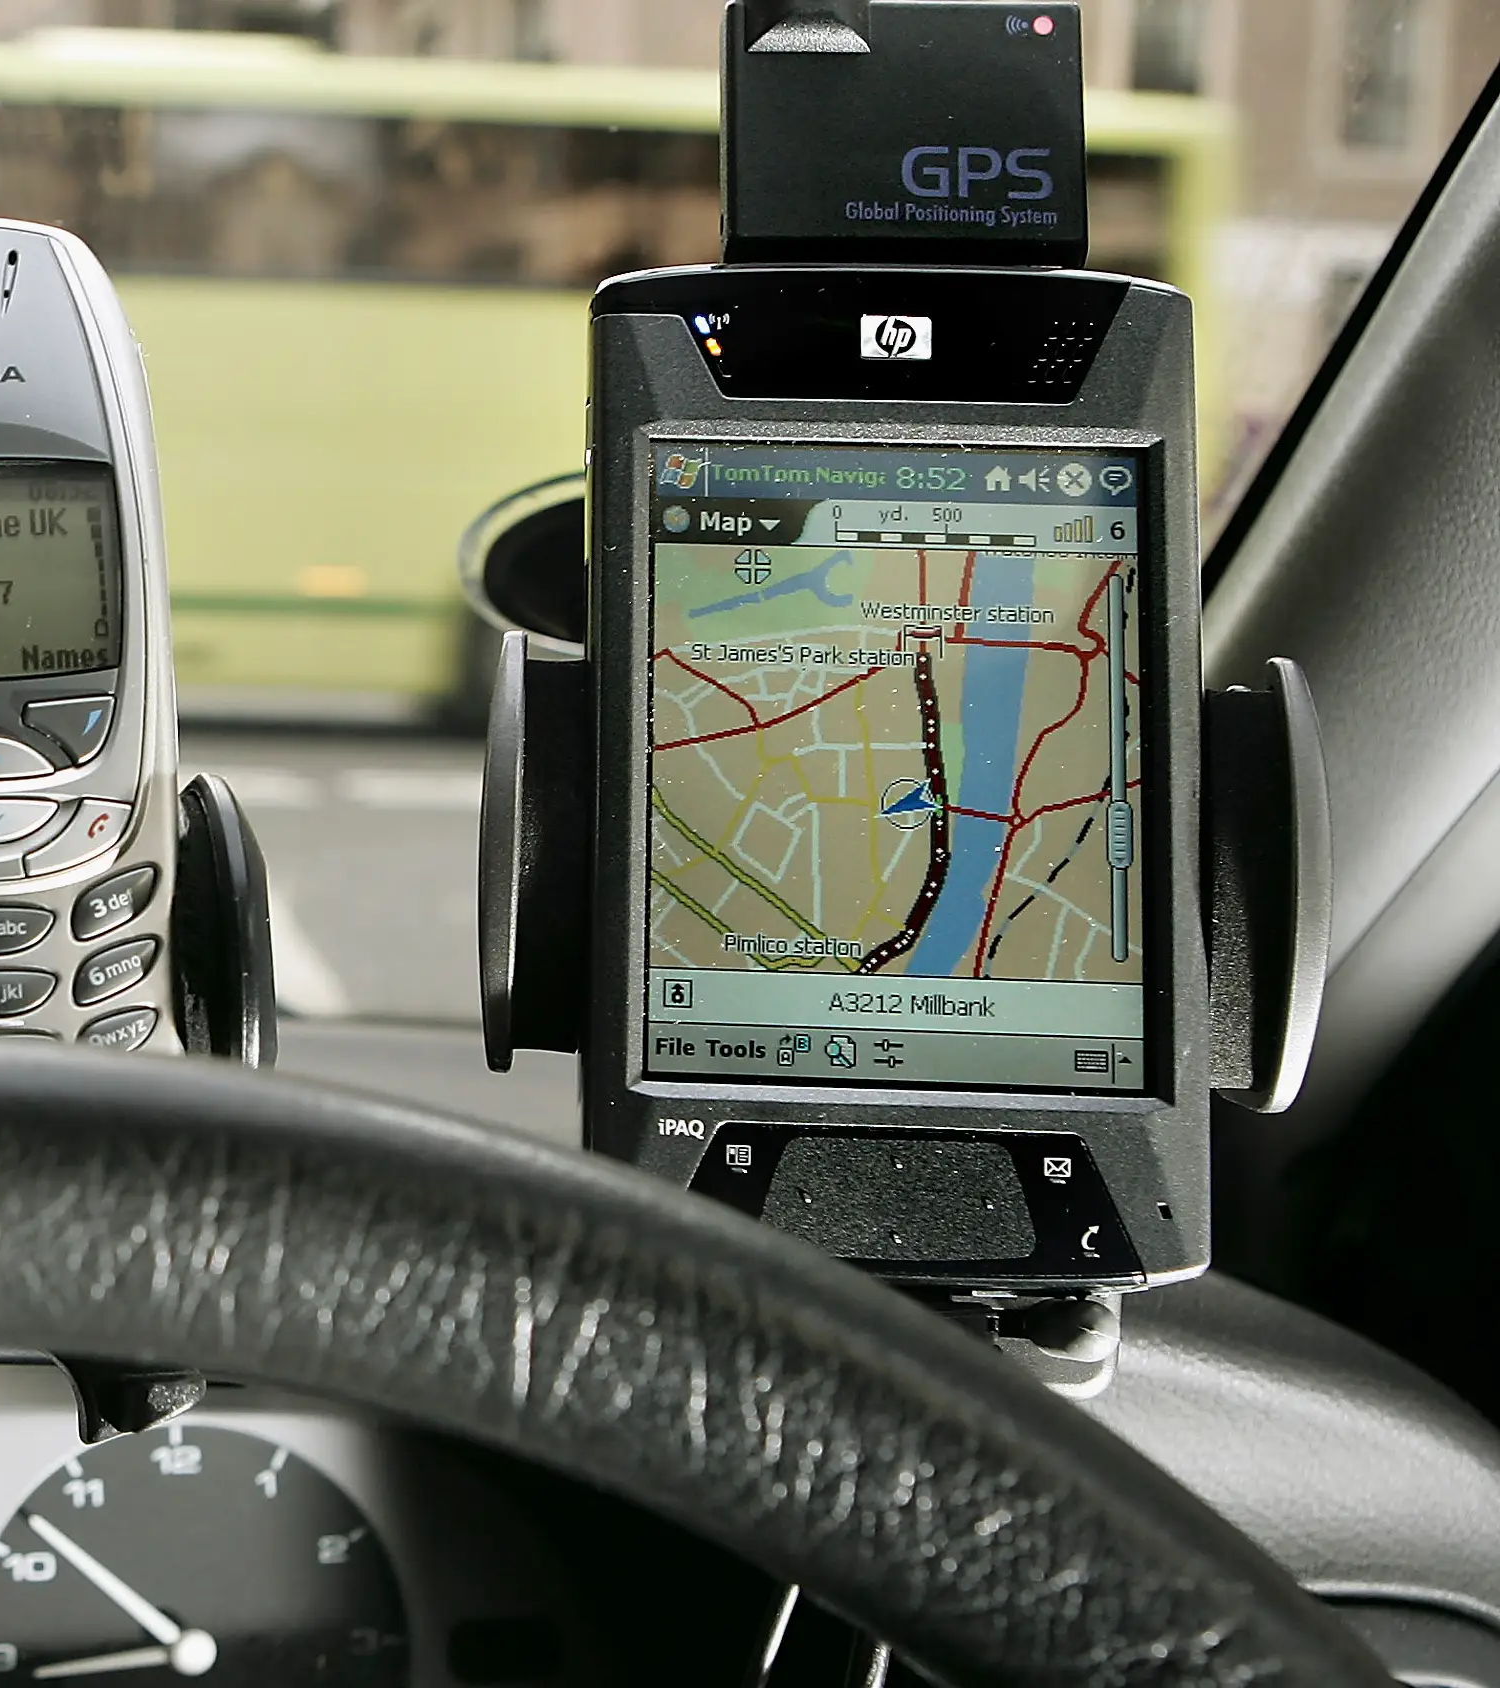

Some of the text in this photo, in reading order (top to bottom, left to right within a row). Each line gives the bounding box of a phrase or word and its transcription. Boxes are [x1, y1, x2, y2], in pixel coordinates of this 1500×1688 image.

[901, 145, 1054, 200] GPS
[845, 201, 1058, 226] Global Positioning System
[880, 315, 912, 357] hp
[711, 464, 810, 483] TomTom
[896, 466, 966, 490] 8:52
[29, 508, 68, 537] UK
[700, 510, 753, 536] Map
[832, 504, 842, 520] 0
[932, 507, 963, 523] 500
[1109, 520, 1126, 541] 6
[860, 601, 1055, 624] Westminster station
[21, 645, 108, 671] Names
[690, 643, 713, 662] St
[800, 646, 843, 666] Park
[847, 648, 915, 667] station
[724, 933, 862, 958] Pimlico station
[0, 984, 23, 1003] jkl
[828, 992, 996, 1018] A3212 Millbank
[655, 1037, 767, 1059] File Tools
[657, 1118, 706, 1140] iPAQ
[150, 1444, 202, 1475] 12
[62, 1477, 106, 1508] 11
[254, 1469, 279, 1499] 1
[316, 1533, 350, 1564] 2
[3, 1551, 57, 1583] 10
